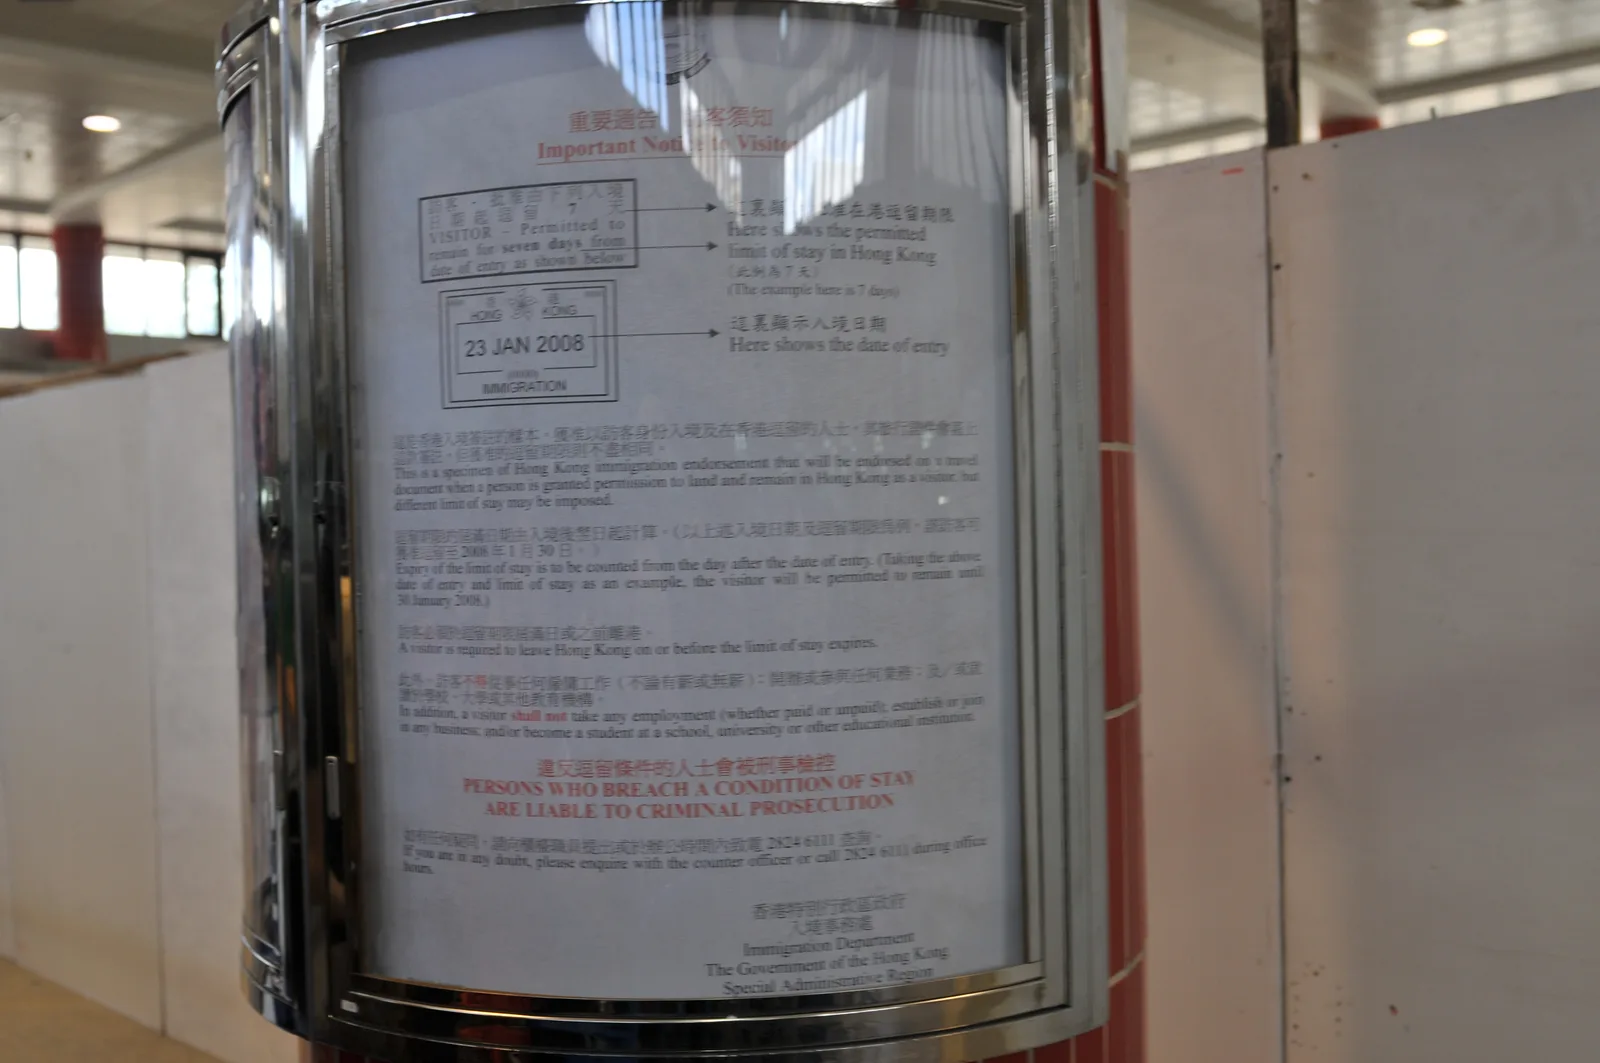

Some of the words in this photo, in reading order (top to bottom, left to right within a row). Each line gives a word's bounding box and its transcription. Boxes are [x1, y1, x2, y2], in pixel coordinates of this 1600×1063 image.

[537, 140, 636, 163] Important
[643, 136, 703, 152] Notie
[568, 203, 578, 215] 7
[429, 227, 492, 244] VISITOR
[521, 218, 598, 236] Permitted
[609, 219, 626, 231] to
[727, 220, 767, 237] Here
[772, 221, 823, 238] sows
[827, 222, 851, 238] the
[855, 225, 927, 242] permitted
[429, 246, 469, 261] remain
[476, 243, 494, 256] for
[502, 241, 540, 253] seven
[549, 238, 583, 253] days
[591, 235, 626, 248] from
[728, 243, 767, 259] limit
[772, 242, 790, 258] of
[793, 245, 825, 263] stay
[830, 243, 847, 259] in
[850, 245, 893, 265] Hong
[896, 246, 938, 266] Kong
[458, 261, 472, 275] of
[476, 260, 505, 275] entry
[514, 258, 528, 269] as
[535, 254, 577, 267] shown
[585, 251, 626, 266] below
[761, 284, 812, 299] example
[814, 284, 842, 297] here
[857, 283, 866, 296] 7
[471, 308, 503, 321] HONG
[541, 304, 578, 317] KONG
[464, 339, 487, 358] 23
[492, 335, 531, 356] JAN
[536, 333, 585, 353] 2008
[729, 336, 769, 353] Here
[773, 336, 825, 352] shows
[828, 336, 853, 352] the
[855, 336, 890, 352] date
[893, 337, 911, 353] of
[912, 340, 950, 357] entry
[482, 379, 568, 395] IMMIGRATION
[514, 462, 549, 477] Hong
[553, 461, 590, 477] Kong
[815, 471, 853, 487] Hong
[855, 471, 890, 487] Kong
[535, 495, 551, 508] be
[509, 563, 532, 577] stay
[566, 561, 583, 574] be
[678, 558, 700, 571] the
[702, 557, 727, 573] day
[765, 555, 788, 569] the
[790, 555, 819, 568] date
[821, 554, 838, 567] of
[554, 643, 592, 659] Hong
[593, 643, 632, 659] Kong
[672, 641, 717, 655] before
[719, 640, 742, 653] the
[631, 708, 717, 725] employment
[462, 777, 544, 797] PERSONS
[548, 780, 599, 797] WHO
[603, 780, 689, 798] BREACH
[696, 781, 709, 796] A
[714, 776, 833, 797] CONDITION
[838, 773, 866, 790] OF
[869, 770, 917, 787] STAY
[484, 801, 521, 817] ARE
[525, 802, 599, 819] LIABLE
[603, 802, 632, 819] TO
[635, 802, 743, 819] CRIMINAL
[751, 793, 895, 817] PROSECUTION
[535, 855, 575, 872] please
[667, 855, 690, 869] the
[692, 856, 743, 869] counter
[796, 853, 811, 865] or
[743, 939, 832, 957] Immigration
[835, 932, 915, 951] Department
[705, 963, 733, 977] The
[736, 957, 826, 977] Government
[829, 954, 847, 970] of
[848, 953, 868, 968] the
[872, 951, 911, 966] Hong
[913, 946, 949, 961] Kong
[722, 979, 775, 997] Special
[780, 971, 883, 992] Administrative
[886, 966, 935, 984] Region
